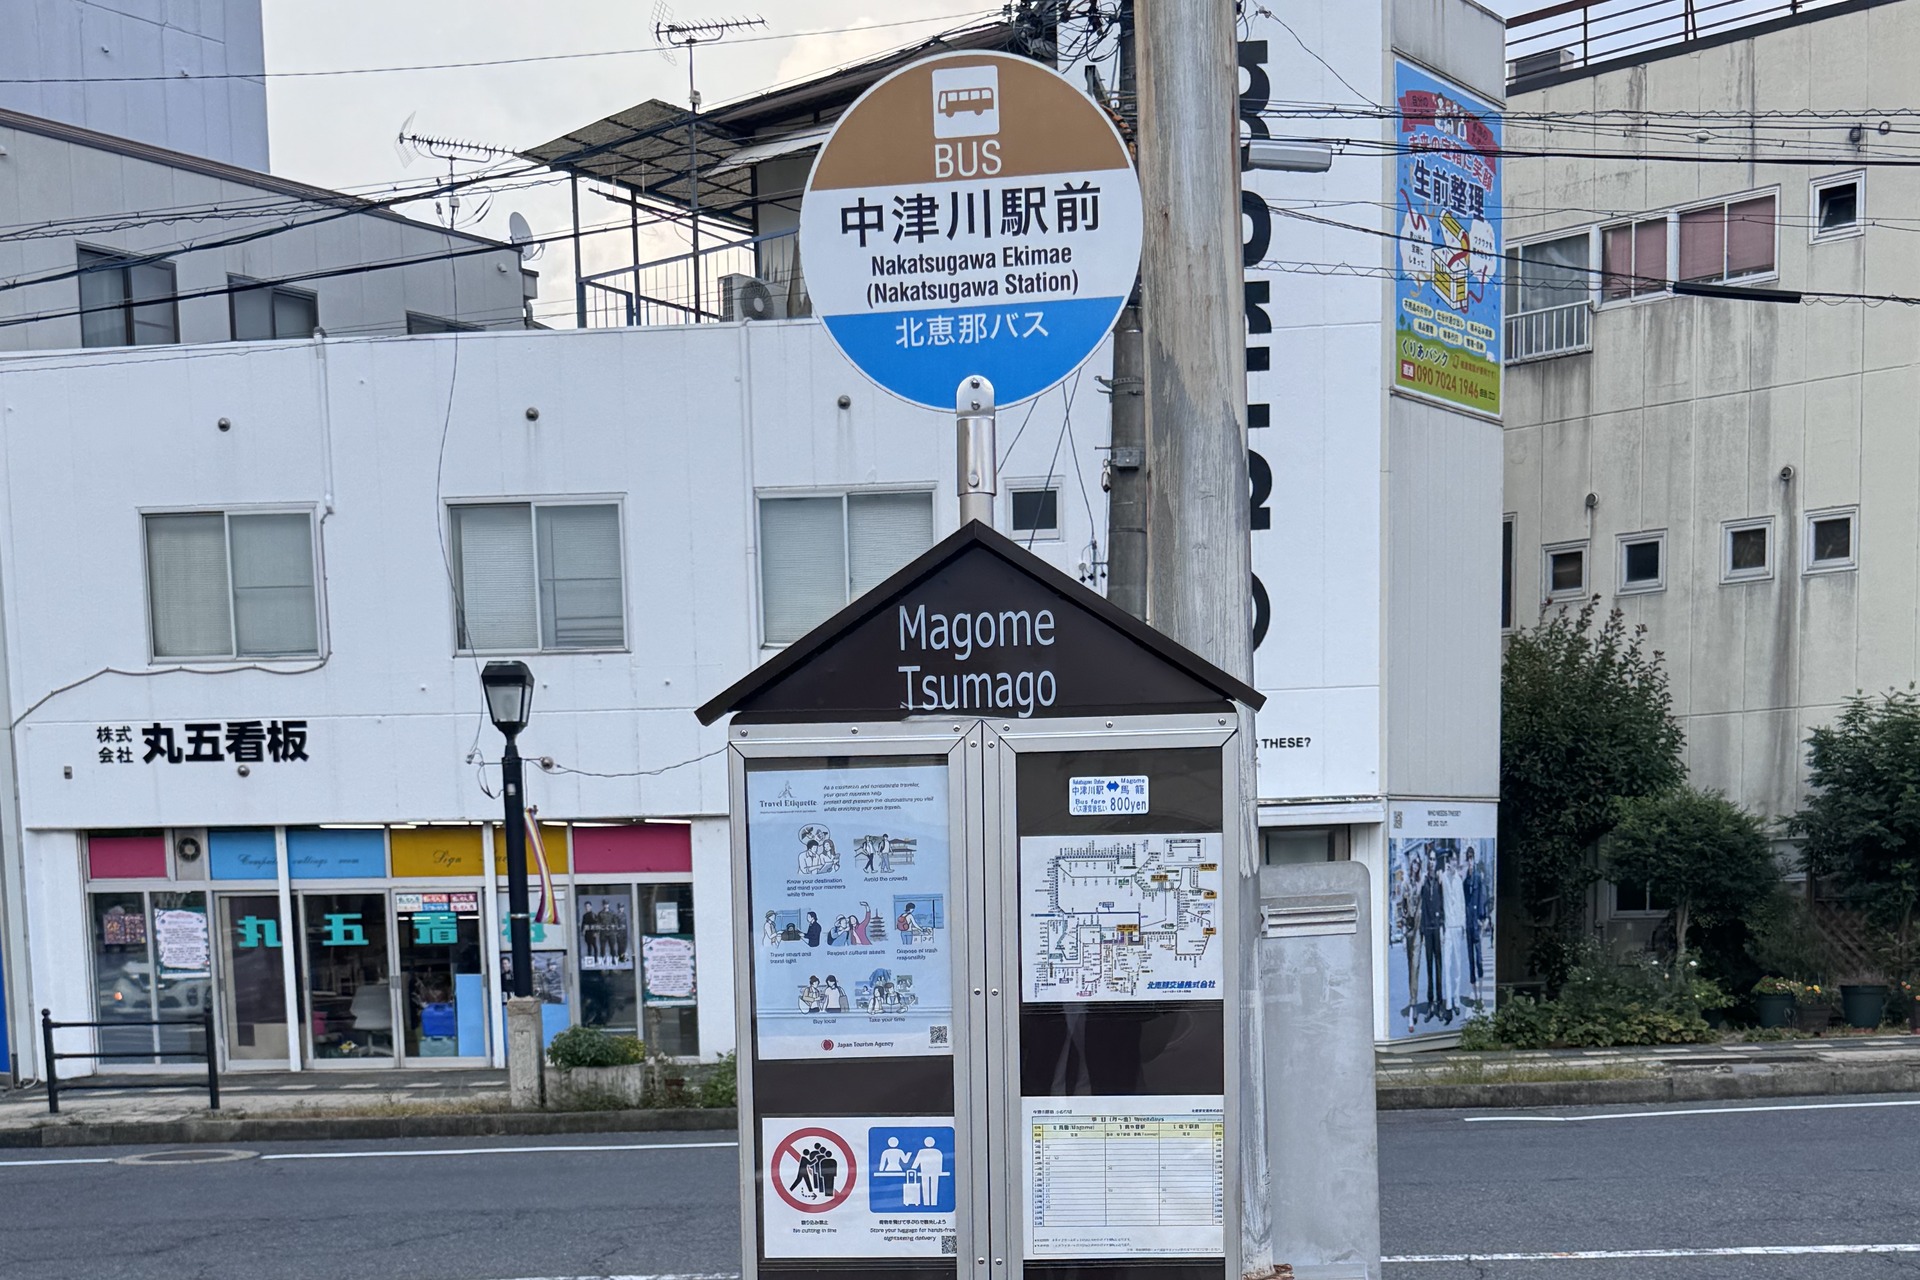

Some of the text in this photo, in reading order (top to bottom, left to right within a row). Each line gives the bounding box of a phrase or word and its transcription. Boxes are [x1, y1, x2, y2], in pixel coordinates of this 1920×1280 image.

[935, 140, 1002, 178] BUS
[1413, 158, 1485, 223] 生前整理
[840, 181, 1101, 248] 中津川駅前
[871, 246, 1072, 277] Nakatsugawa Ekimae
[867, 270, 1079, 308] (Nakatsugawa Station)
[895, 311, 1049, 349] 北恵那バス
[1402, 338, 1448, 367] くりあバンク
[1416, 364, 1434, 386] 090
[1435, 369, 1457, 393] 7024
[1458, 377, 1479, 399] 1946
[899, 605, 1055, 661] Magome
[898, 665, 1057, 718] Tsumago
[96, 725, 133, 743] 株式
[141, 720, 309, 764] 丸五看板
[1261, 737, 1312, 749] THESE?
[98, 746, 134, 763] 会社
[759, 799, 817, 809] Travel Etiquette
[1072, 786, 1104, 796] 中津川駅
[1110, 797, 1147, 813] 800yen
